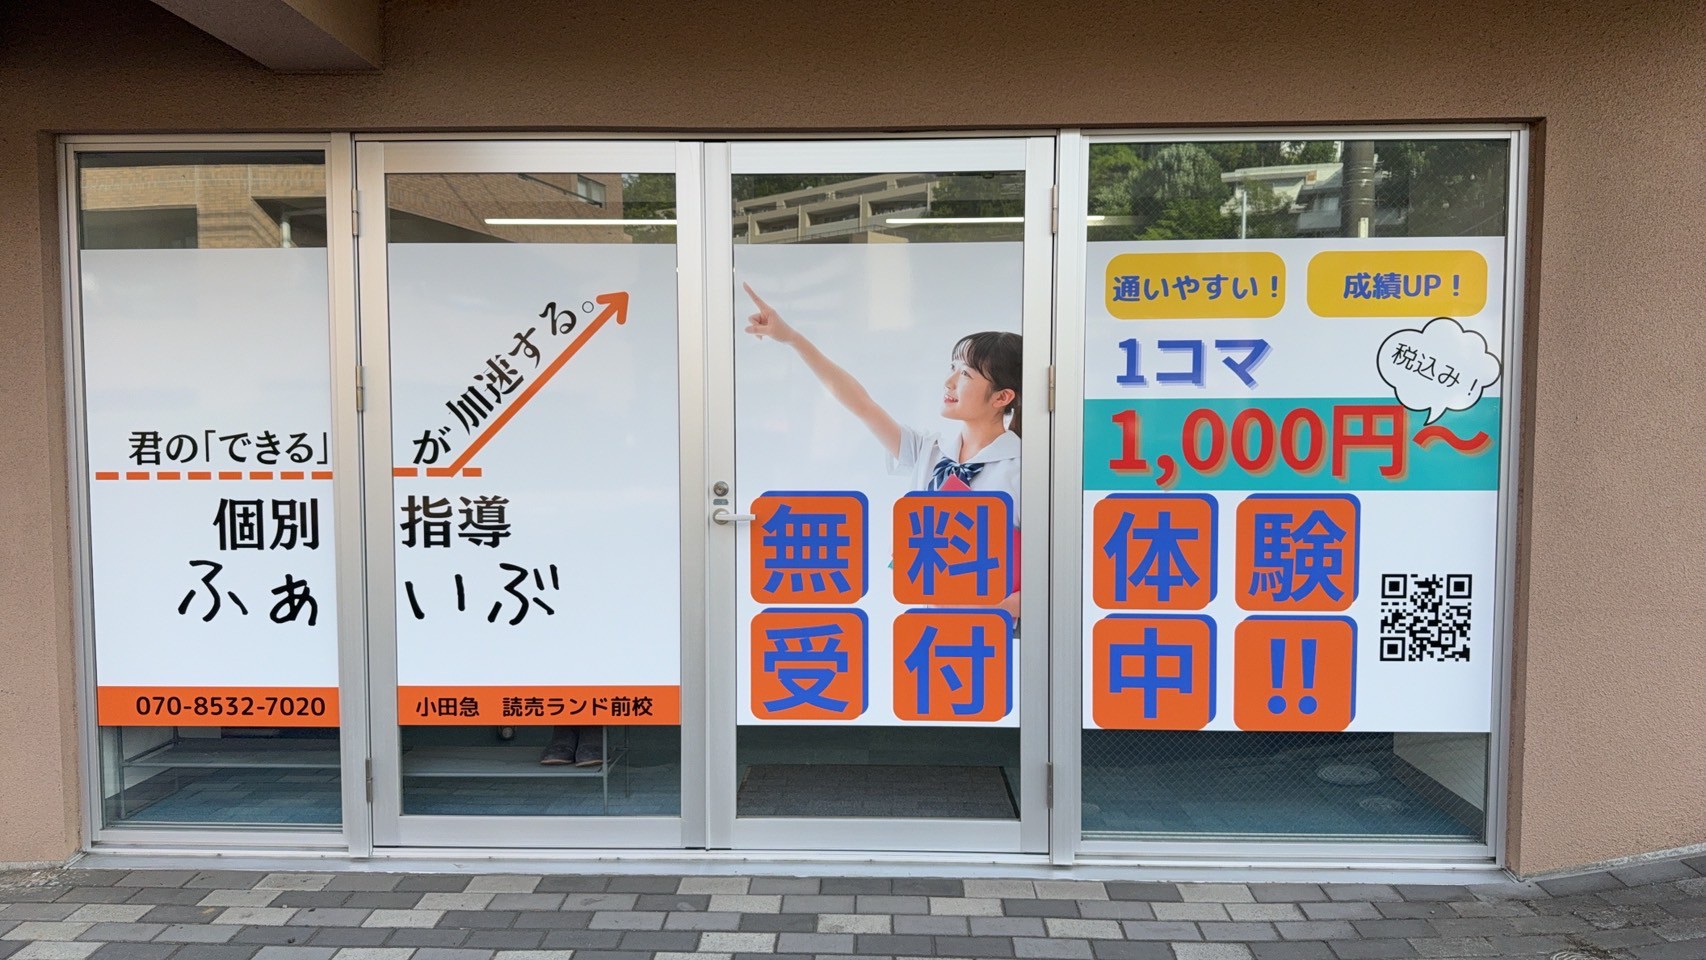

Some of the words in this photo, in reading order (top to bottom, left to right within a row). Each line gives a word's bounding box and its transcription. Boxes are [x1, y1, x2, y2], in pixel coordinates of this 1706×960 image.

[1112, 273, 1280, 303] 通いやすい！
[1343, 271, 1461, 300] 成績UP！
[128, 429, 329, 466] 君の「できる」
[412, 300, 595, 465] が加速する。
[1115, 337, 1273, 389] 1コマ
[1391, 342, 1480, 397] 税込み！
[212, 498, 320, 551] 個別
[400, 495, 512, 549] 指導
[135, 696, 326, 717] 070-8532-7020
[416, 696, 480, 717] 小田急
[502, 696, 653, 717] 読売ランド前校
